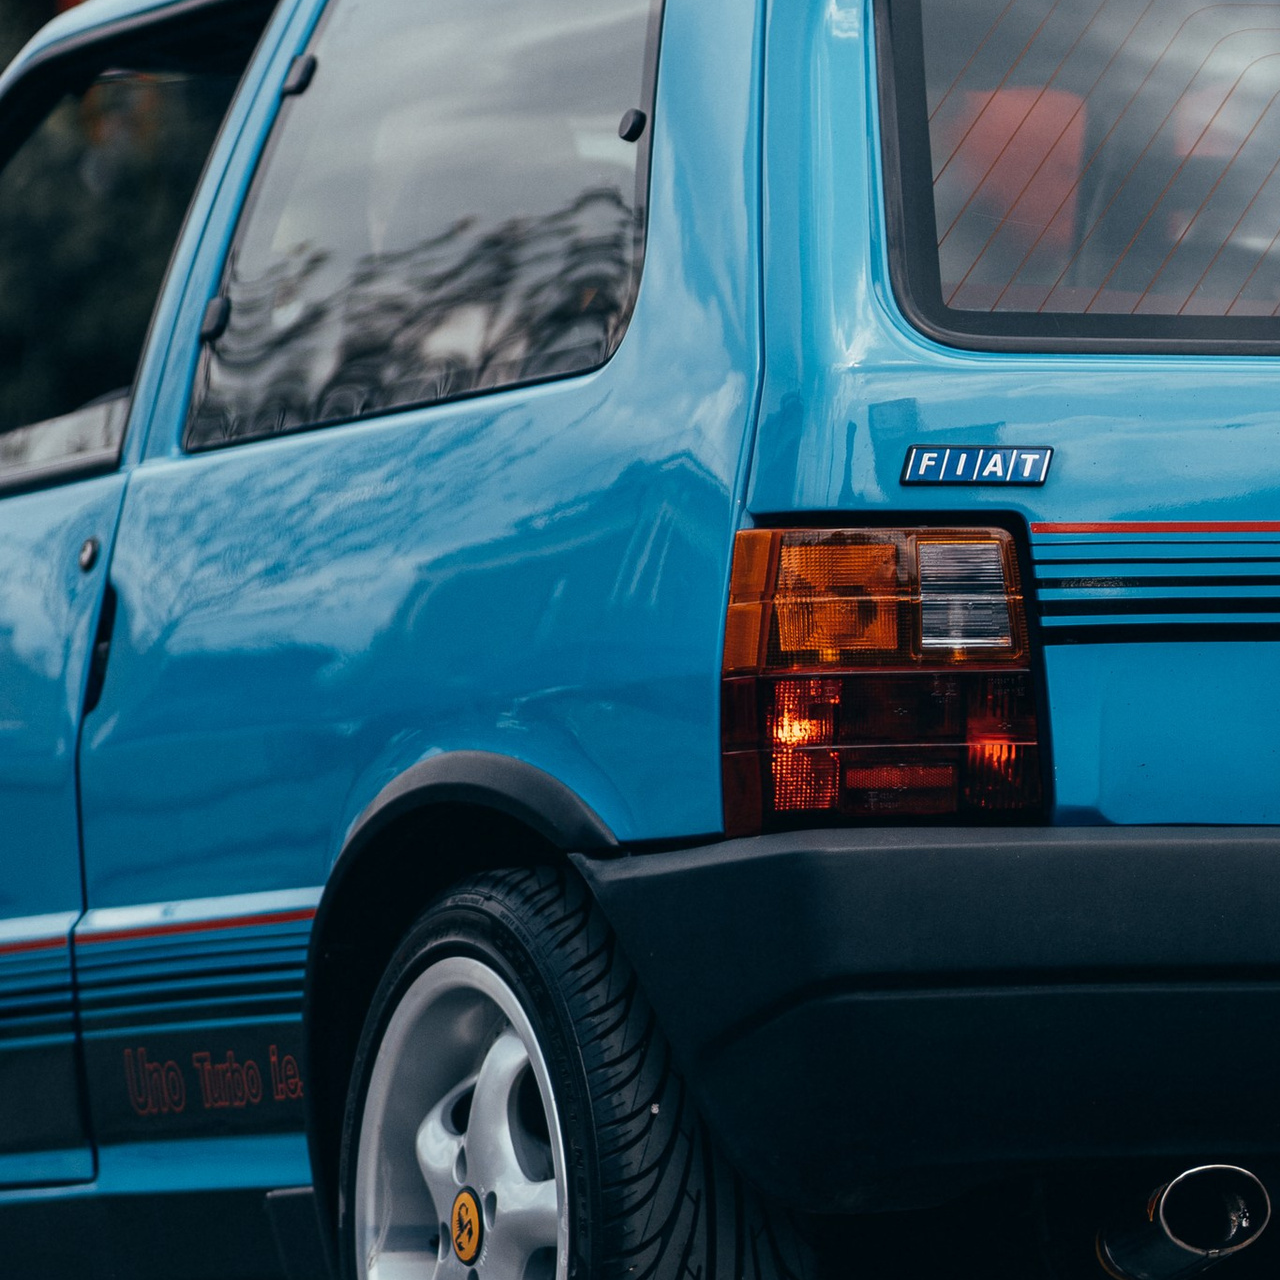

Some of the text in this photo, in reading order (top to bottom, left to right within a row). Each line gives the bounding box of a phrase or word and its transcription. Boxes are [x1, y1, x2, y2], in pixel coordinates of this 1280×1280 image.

[908, 452, 1040, 477] FIAT
[124, 1047, 186, 1115] Uno
[192, 1050, 262, 1108] Turbo
